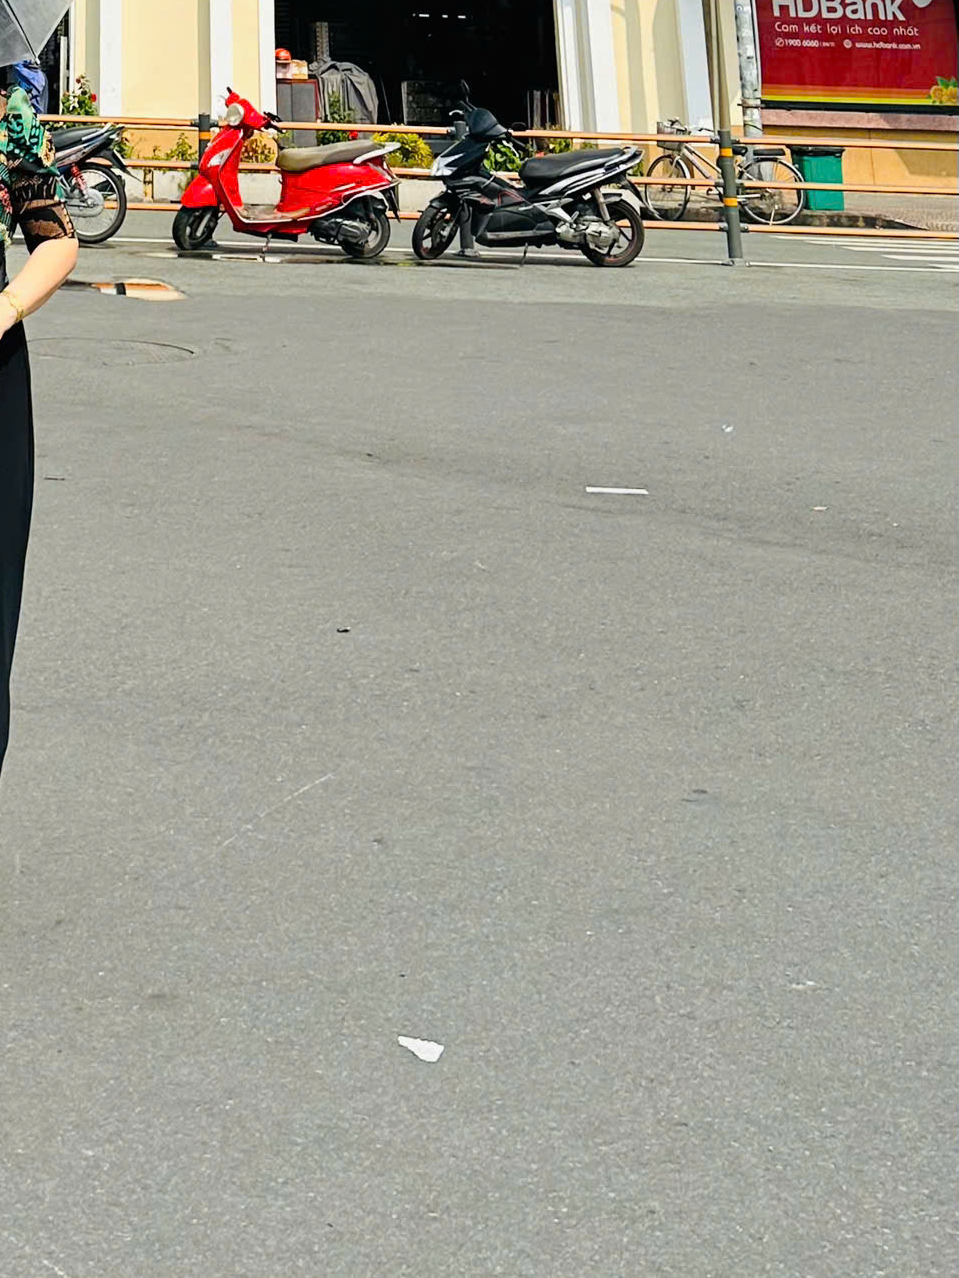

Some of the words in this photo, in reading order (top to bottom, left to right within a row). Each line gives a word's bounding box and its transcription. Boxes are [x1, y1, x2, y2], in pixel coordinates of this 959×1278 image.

[774, 21, 799, 33] Cam
[803, 22, 822, 34] kết
[867, 27, 888, 35] cao
